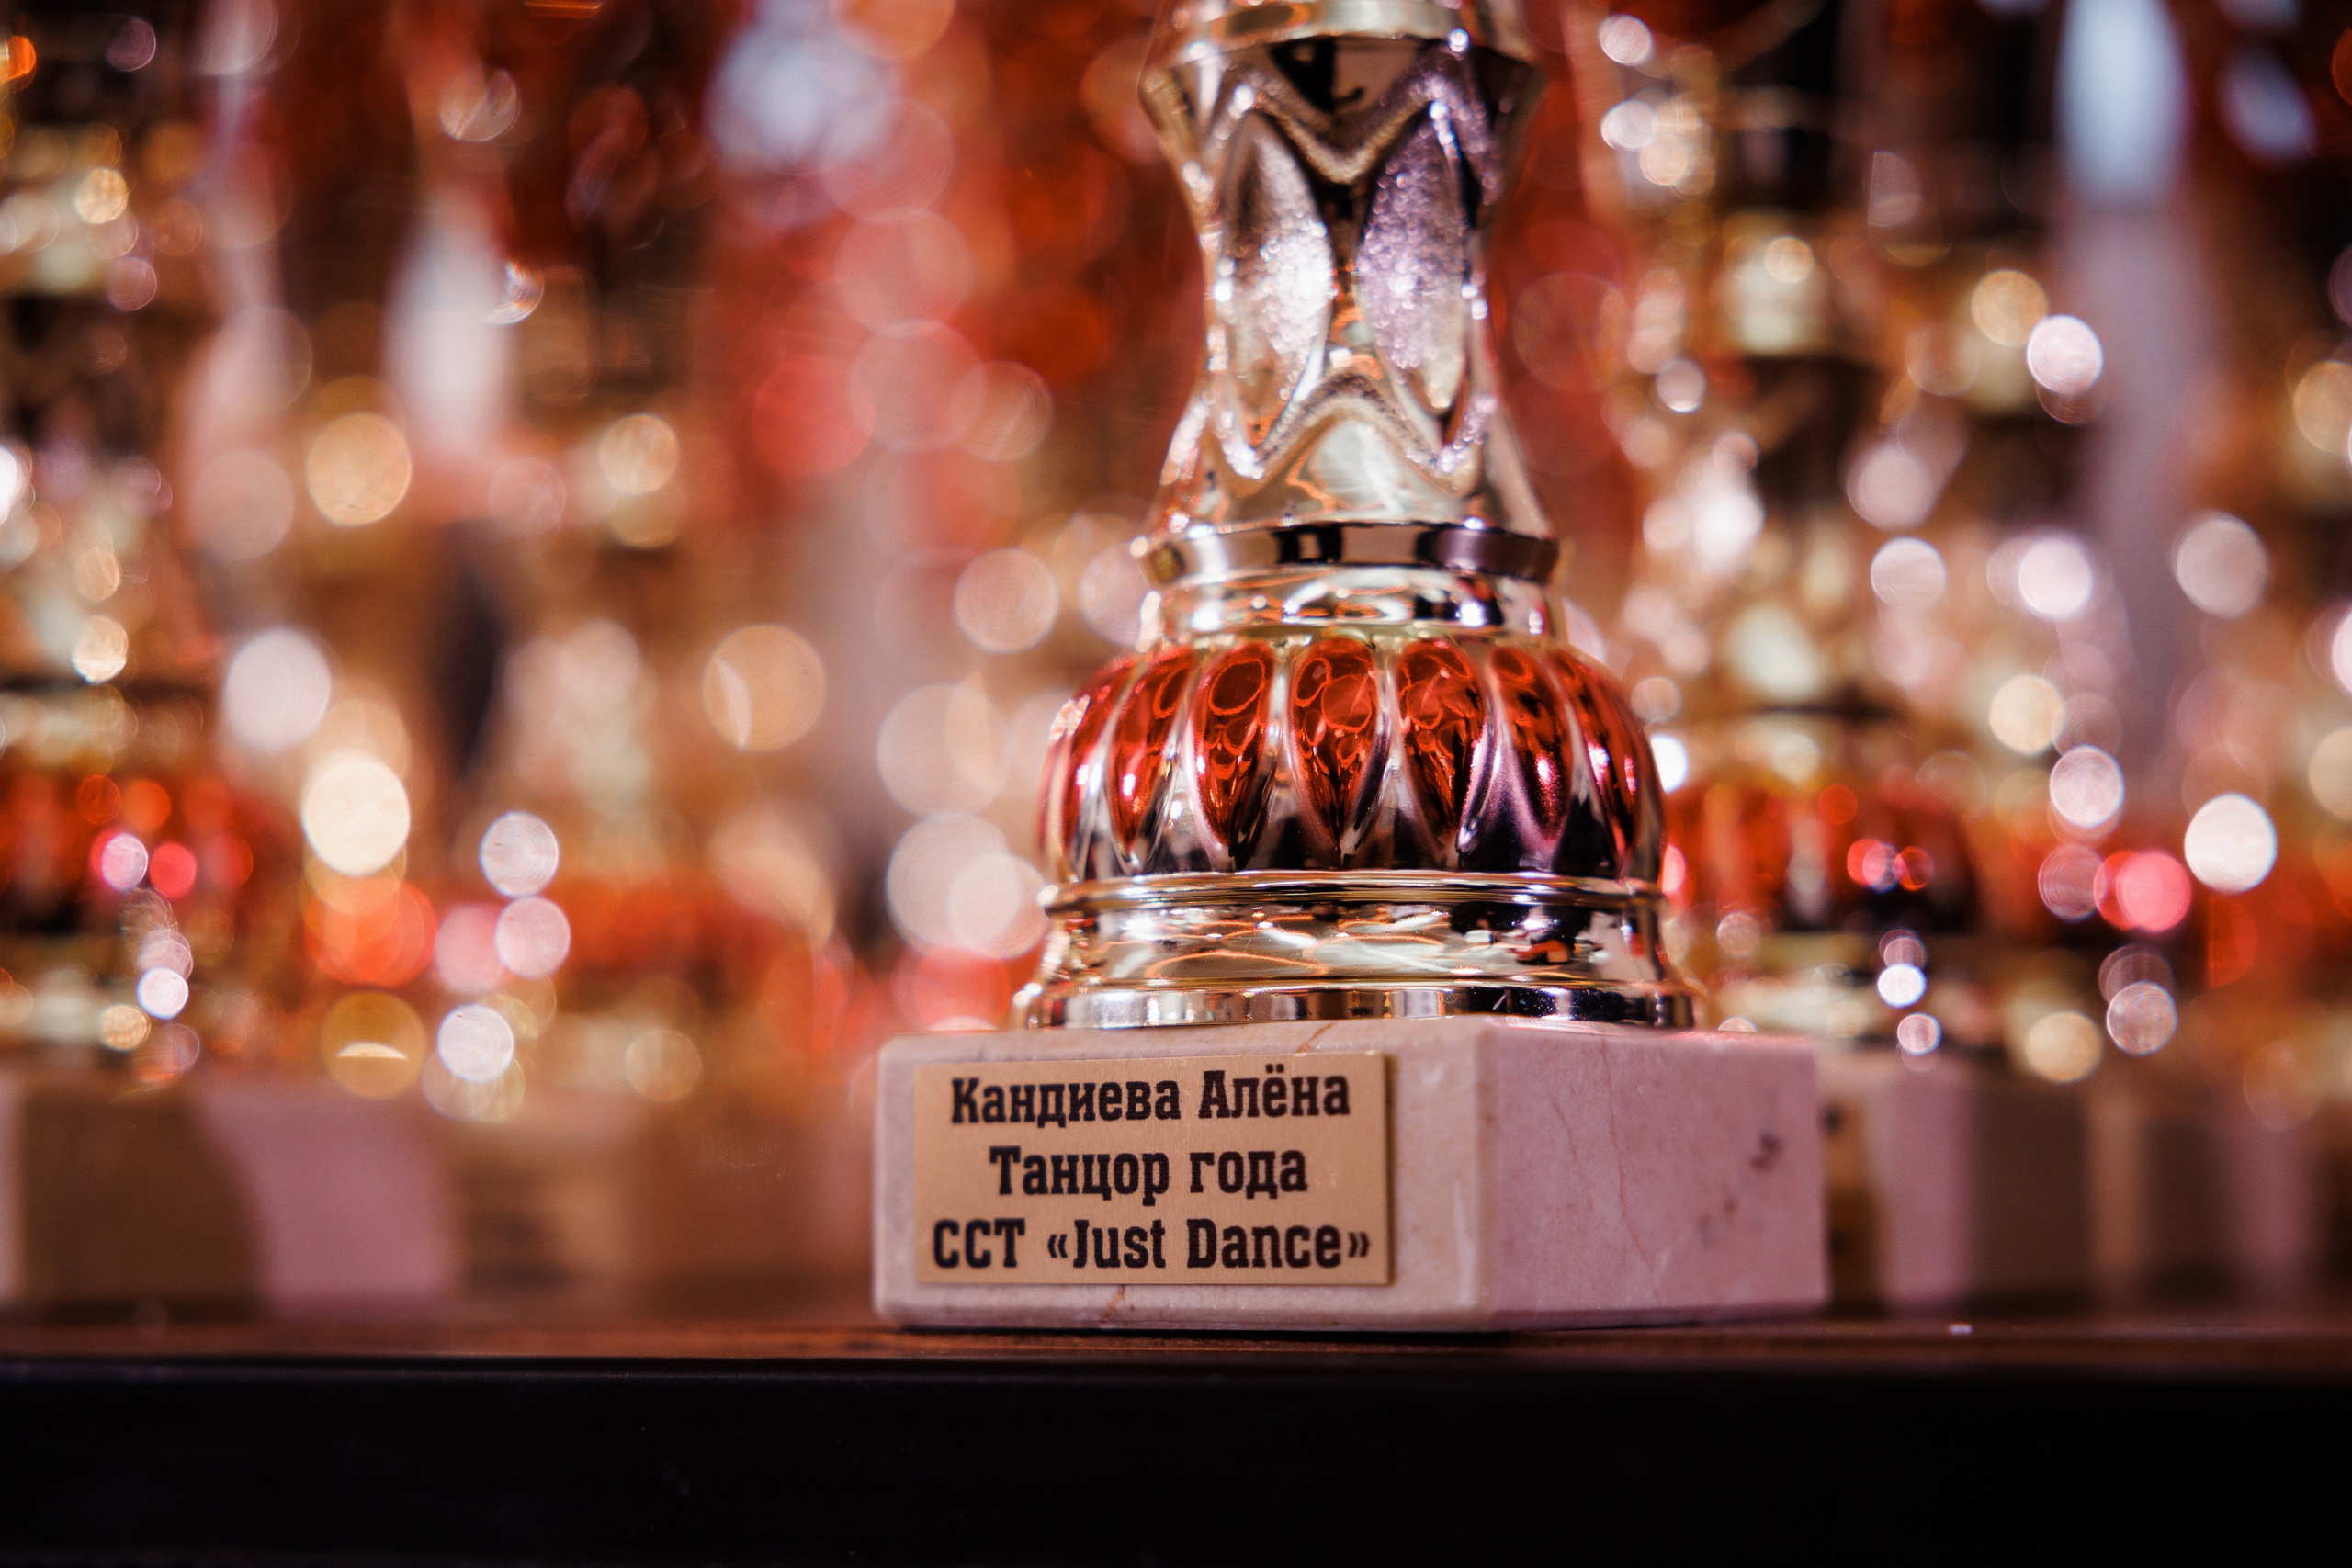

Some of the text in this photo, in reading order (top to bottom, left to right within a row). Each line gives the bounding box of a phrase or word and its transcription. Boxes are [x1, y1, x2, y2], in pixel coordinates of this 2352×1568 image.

[950, 1063, 1351, 1129] Кандиева Алёна
[989, 1145, 1309, 1207] Танцор года
[1046, 1218, 1168, 1269] «Just
[1186, 1217, 1371, 1269] Dance»
